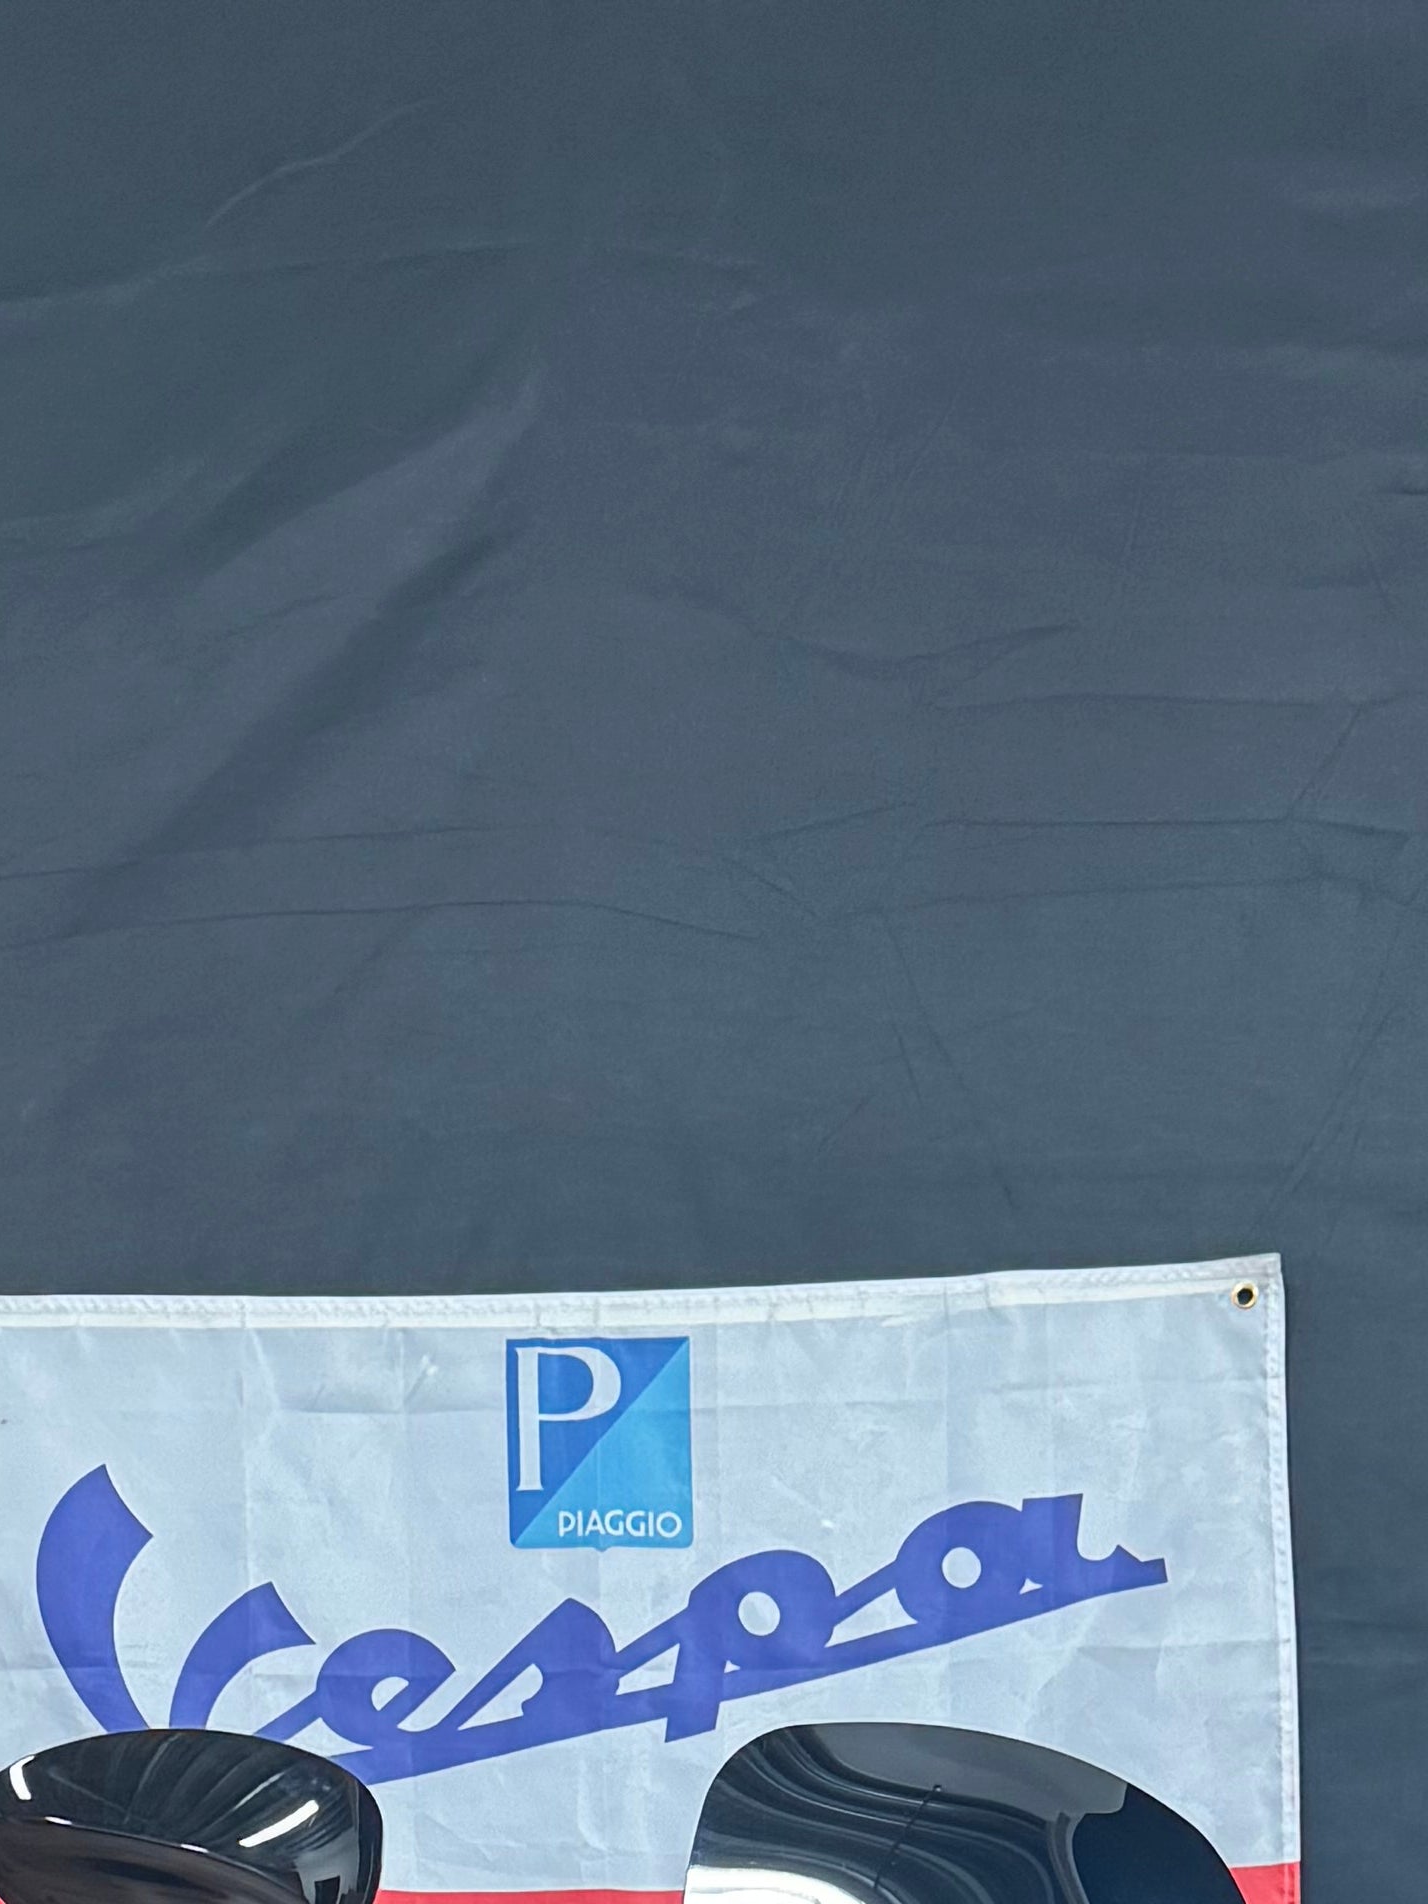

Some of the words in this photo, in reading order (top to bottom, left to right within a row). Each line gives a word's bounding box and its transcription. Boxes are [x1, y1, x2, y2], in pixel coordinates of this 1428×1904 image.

[516, 1346, 621, 1491] P
[558, 1509, 682, 1538] PIAGGIO
[37, 1464, 1167, 1785] Vespa
